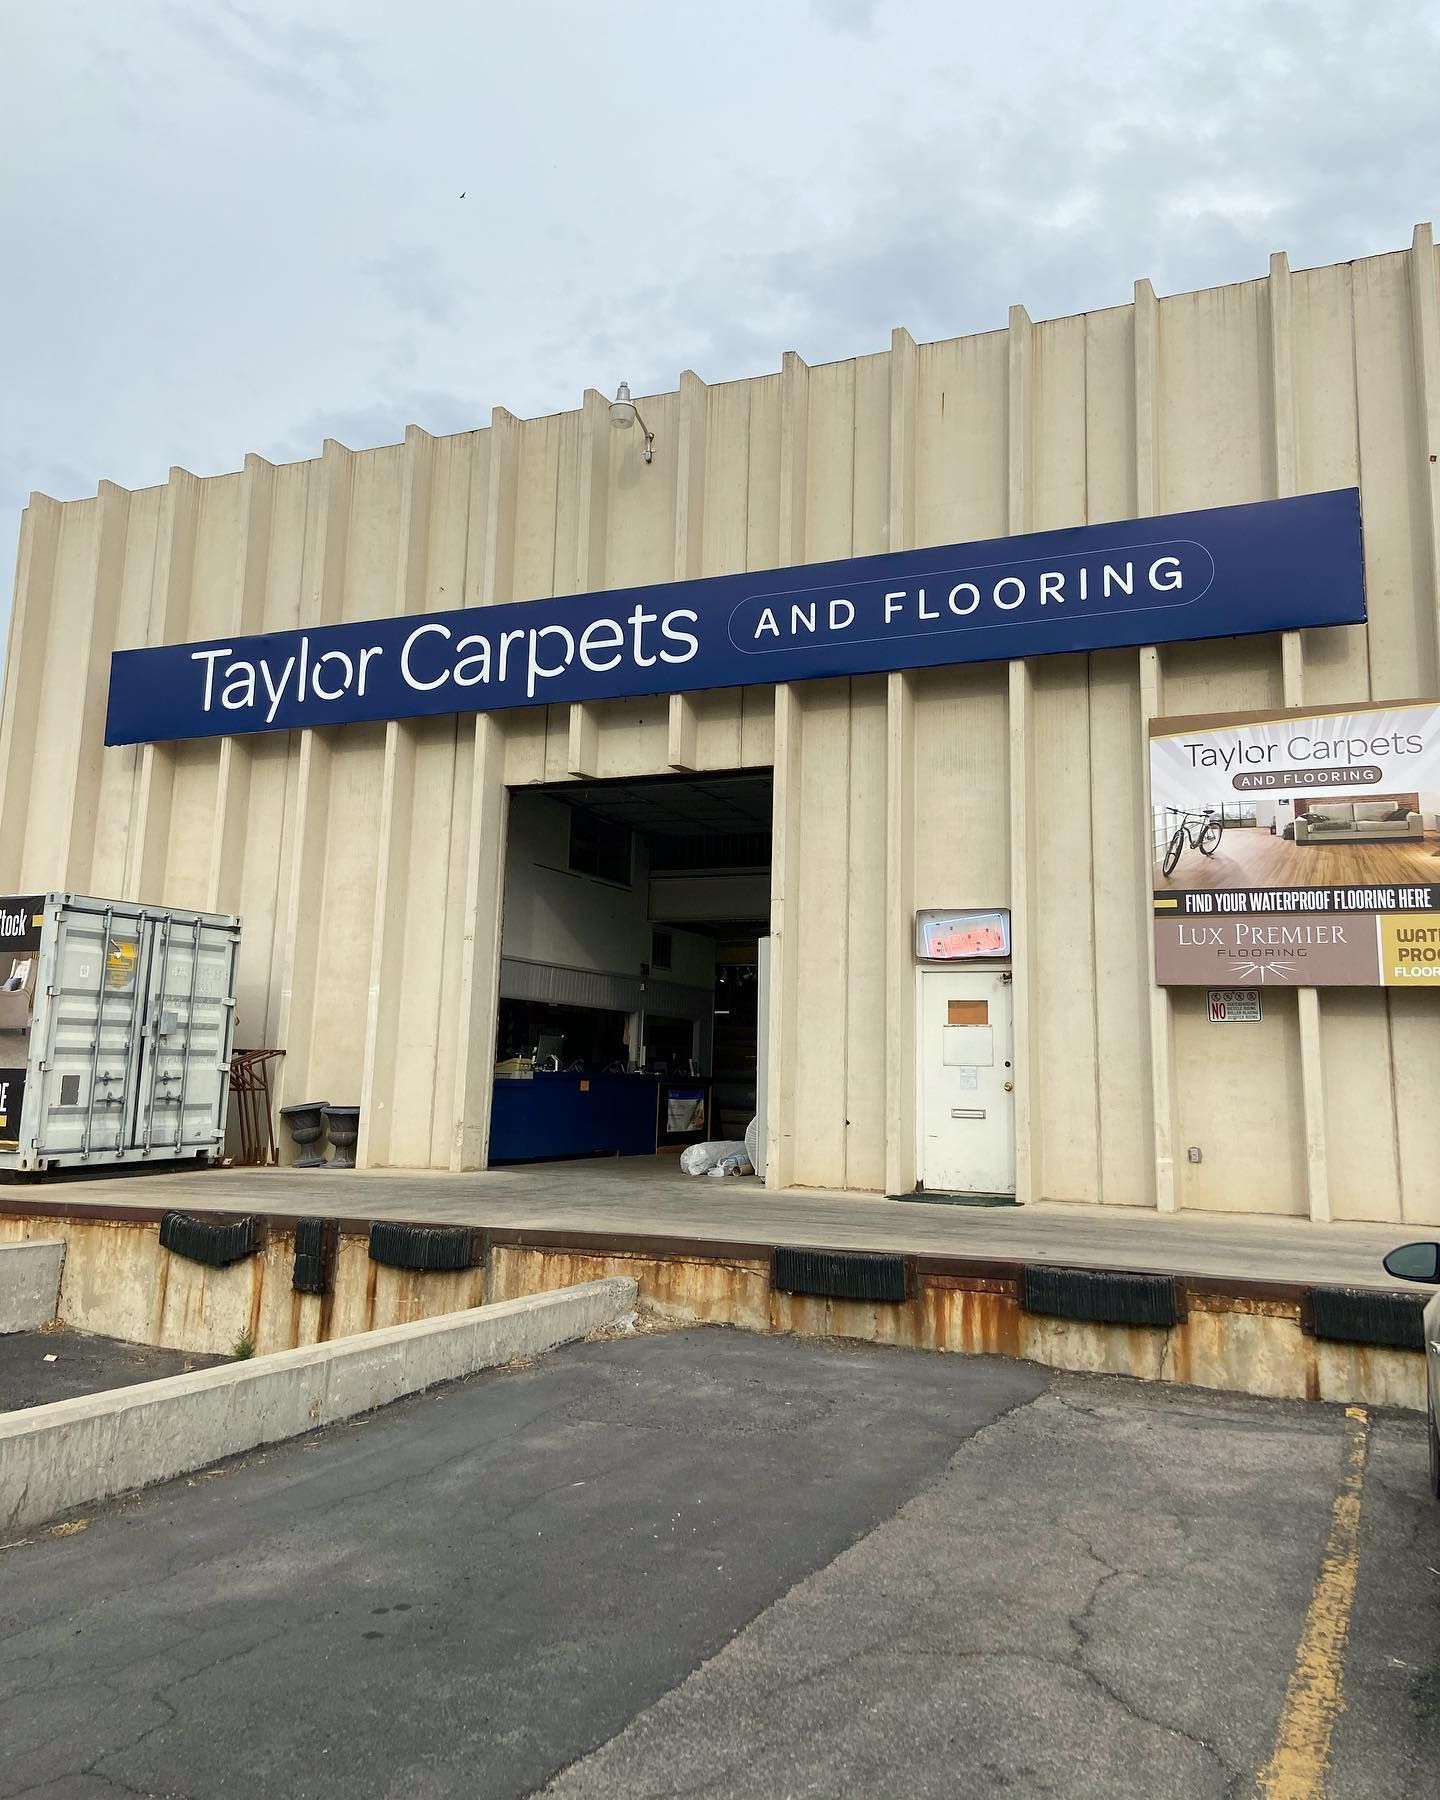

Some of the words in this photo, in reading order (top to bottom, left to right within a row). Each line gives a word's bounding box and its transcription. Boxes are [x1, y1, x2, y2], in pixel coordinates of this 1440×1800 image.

[755, 599, 855, 639] AND
[884, 556, 1183, 624] FLOORING
[191, 637, 383, 724] Taylor
[401, 604, 699, 698] Carpets
[1184, 739, 1278, 772] Taylor
[1287, 732, 1423, 765] Carpets
[1241, 775, 1275, 786] AND
[1283, 769, 1374, 784] FLOORING
[1185, 894, 1213, 913] FIND
[1214, 893, 1248, 912] YOUR
[1249, 891, 1331, 911] WATERPROOF
[1333, 889, 1396, 910] FLOORING
[1398, 888, 1433, 908] HERE
[0, 908, 27, 936] tock
[1396, 928, 1440, 943] WAT
[1217, 948, 1308, 958] FLOORING
[1398, 947, 1440, 961] PRO
[1212, 1002, 1226, 1020] NO
